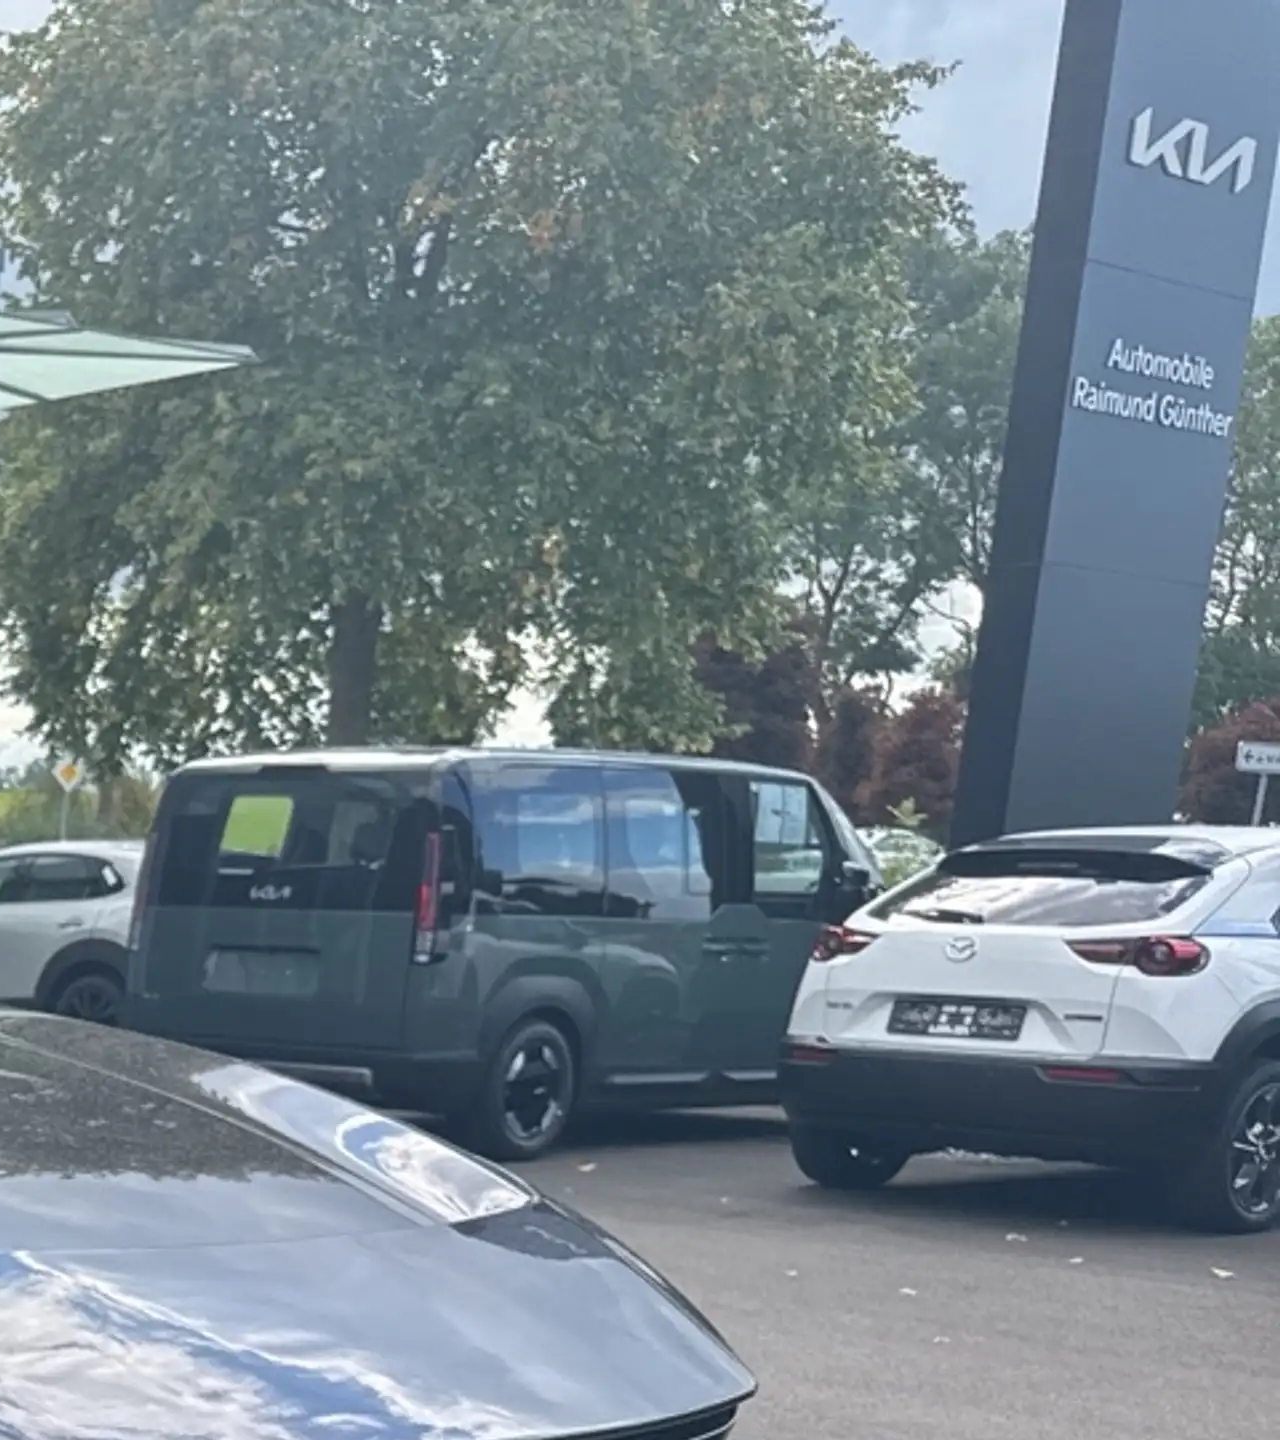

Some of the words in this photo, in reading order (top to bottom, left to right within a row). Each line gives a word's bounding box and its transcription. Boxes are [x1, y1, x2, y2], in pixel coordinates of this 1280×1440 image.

[1130, 107, 1257, 193] KIA
[1107, 338, 1215, 388] Automobile
[1073, 377, 1157, 422] Raimund
[1160, 395, 1233, 437] Günther
